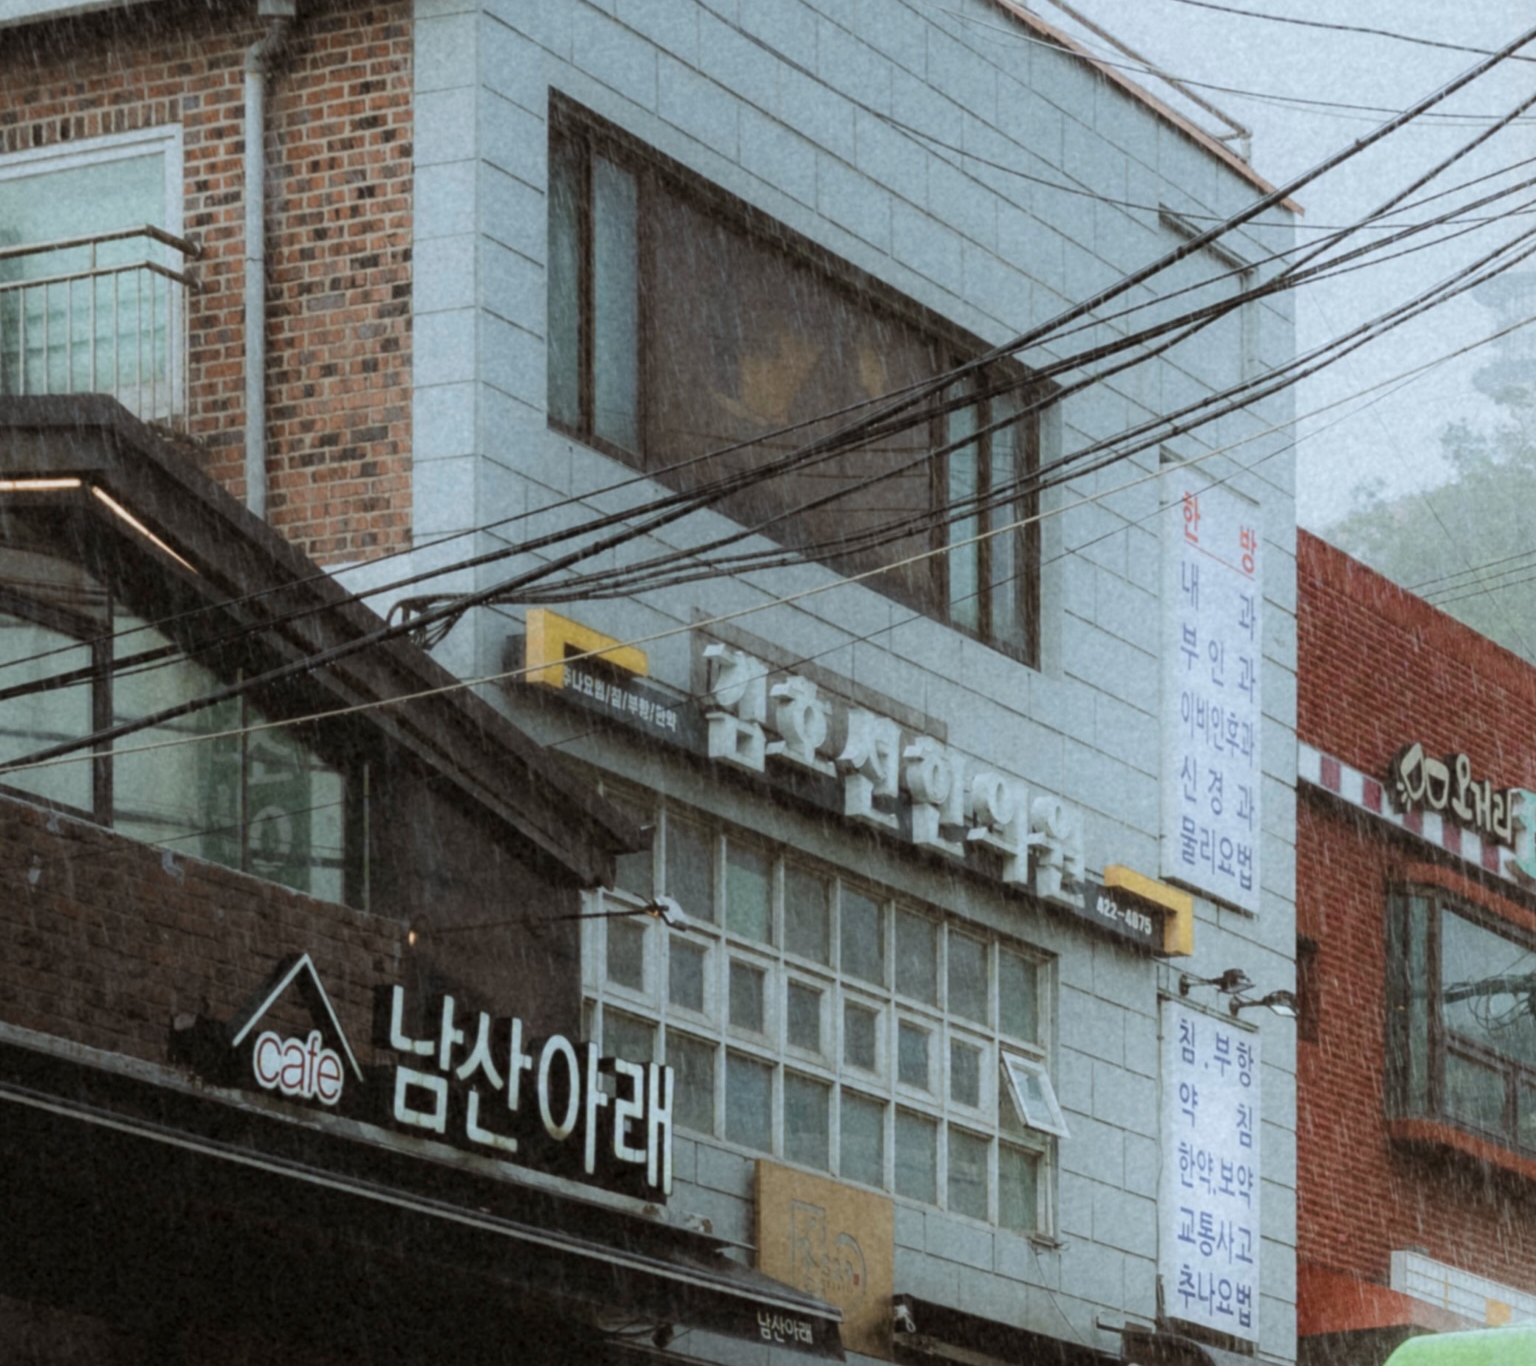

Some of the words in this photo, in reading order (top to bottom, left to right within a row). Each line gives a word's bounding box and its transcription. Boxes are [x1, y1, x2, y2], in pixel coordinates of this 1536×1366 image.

[1181, 691, 1255, 768] 이비인후과
[1180, 815, 1252, 892] 물리요법
[255, 1032, 343, 1104] cafe
[389, 984, 675, 1197] 남산아래
[1177, 1206, 1253, 1265] 교통사고
[757, 1310, 814, 1344] 남산아래
[1177, 1265, 1252, 1328] 추나요법
